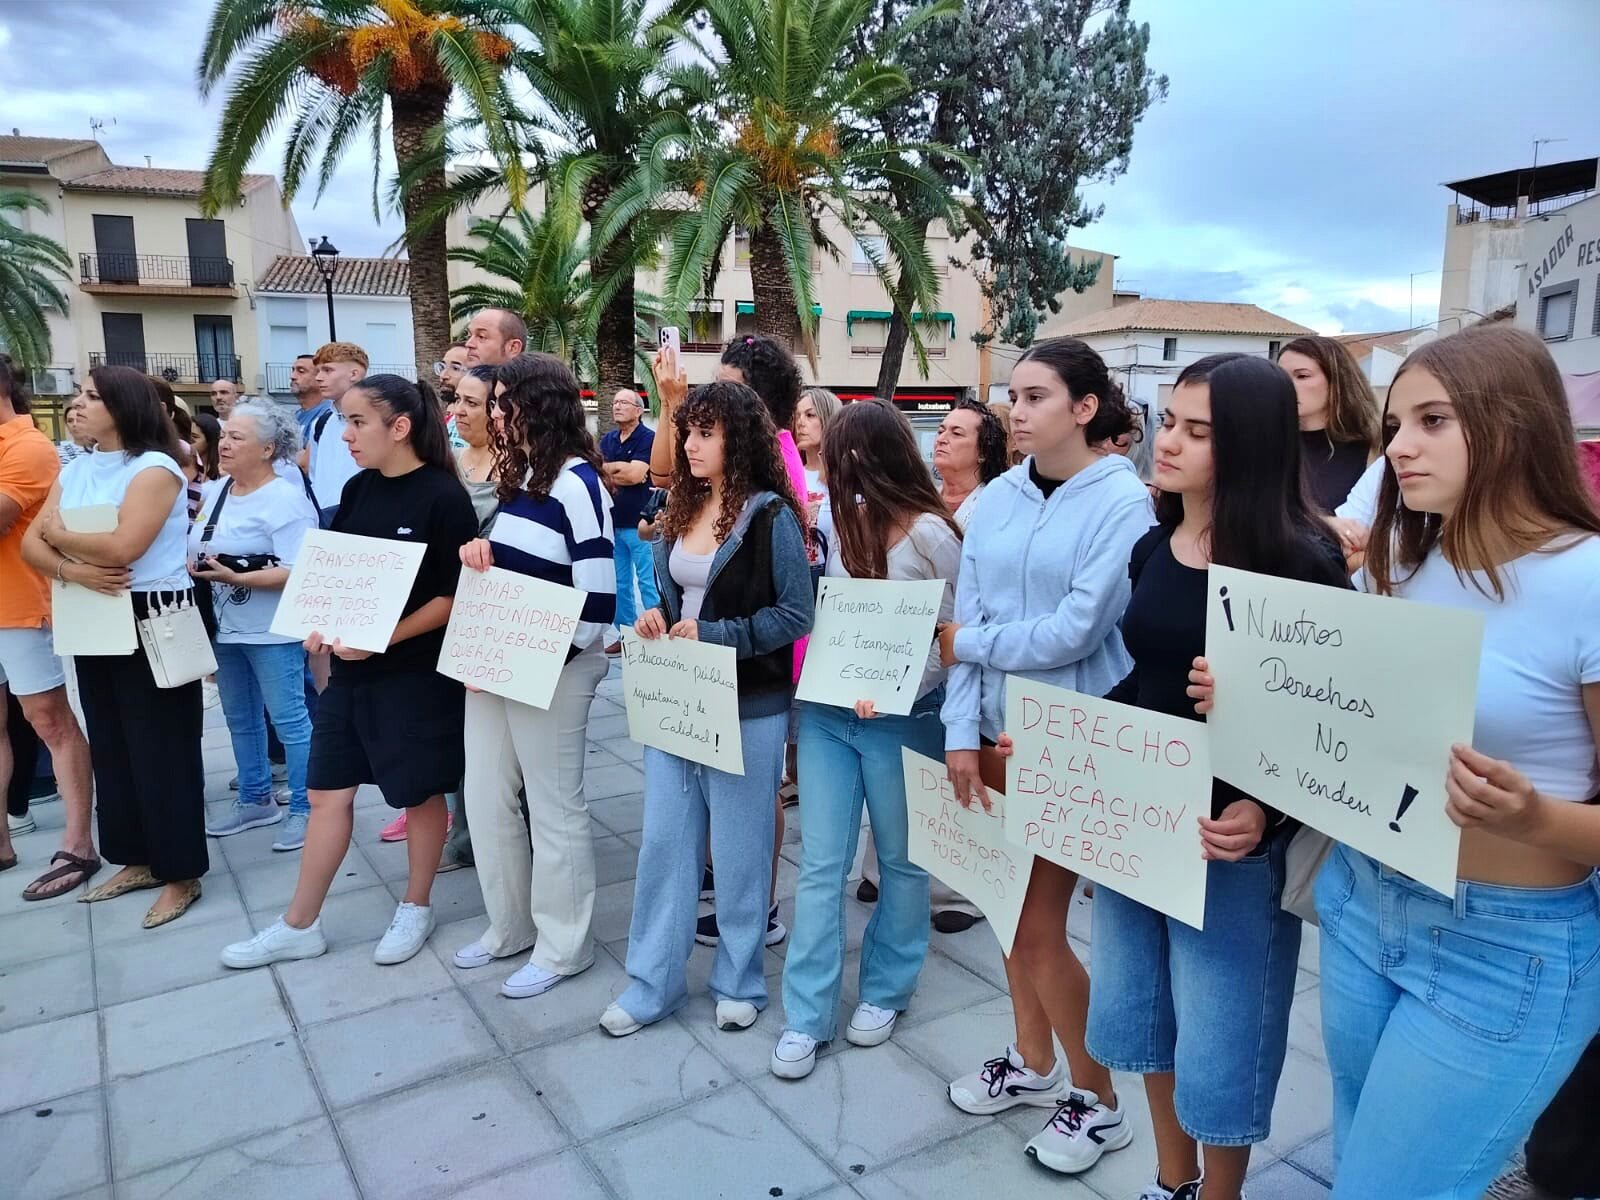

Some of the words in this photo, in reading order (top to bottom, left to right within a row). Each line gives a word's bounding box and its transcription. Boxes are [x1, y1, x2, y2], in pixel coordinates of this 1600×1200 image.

[1528, 223, 1574, 299] ASADOR
[305, 545, 407, 570] TRANSPORTE
[301, 571, 377, 591] ESCOLAR
[463, 574, 525, 600] MISMAS
[295, 593, 333, 610] PARA
[338, 596, 380, 611] TODOS
[894, 599, 936, 616] derecho
[300, 613, 331, 626] LOS
[456, 600, 576, 635] OPORTUNIDADES
[485, 626, 560, 654] PUEBLOS
[829, 630, 846, 648] al
[851, 630, 915, 661] transporte
[456, 663, 514, 683] CIUDAD
[1259, 657, 1375, 718] Derechos
[1022, 696, 1191, 767] DERECHO
[1038, 746, 1054, 768] A
[1067, 753, 1097, 781] LA
[939, 802, 964, 829] AL
[1040, 802, 1073, 824] EN
[1080, 814, 1129, 841] LOS
[914, 811, 1017, 881] TRANSPORTE
[1024, 822, 1143, 879] PUEBLOS
